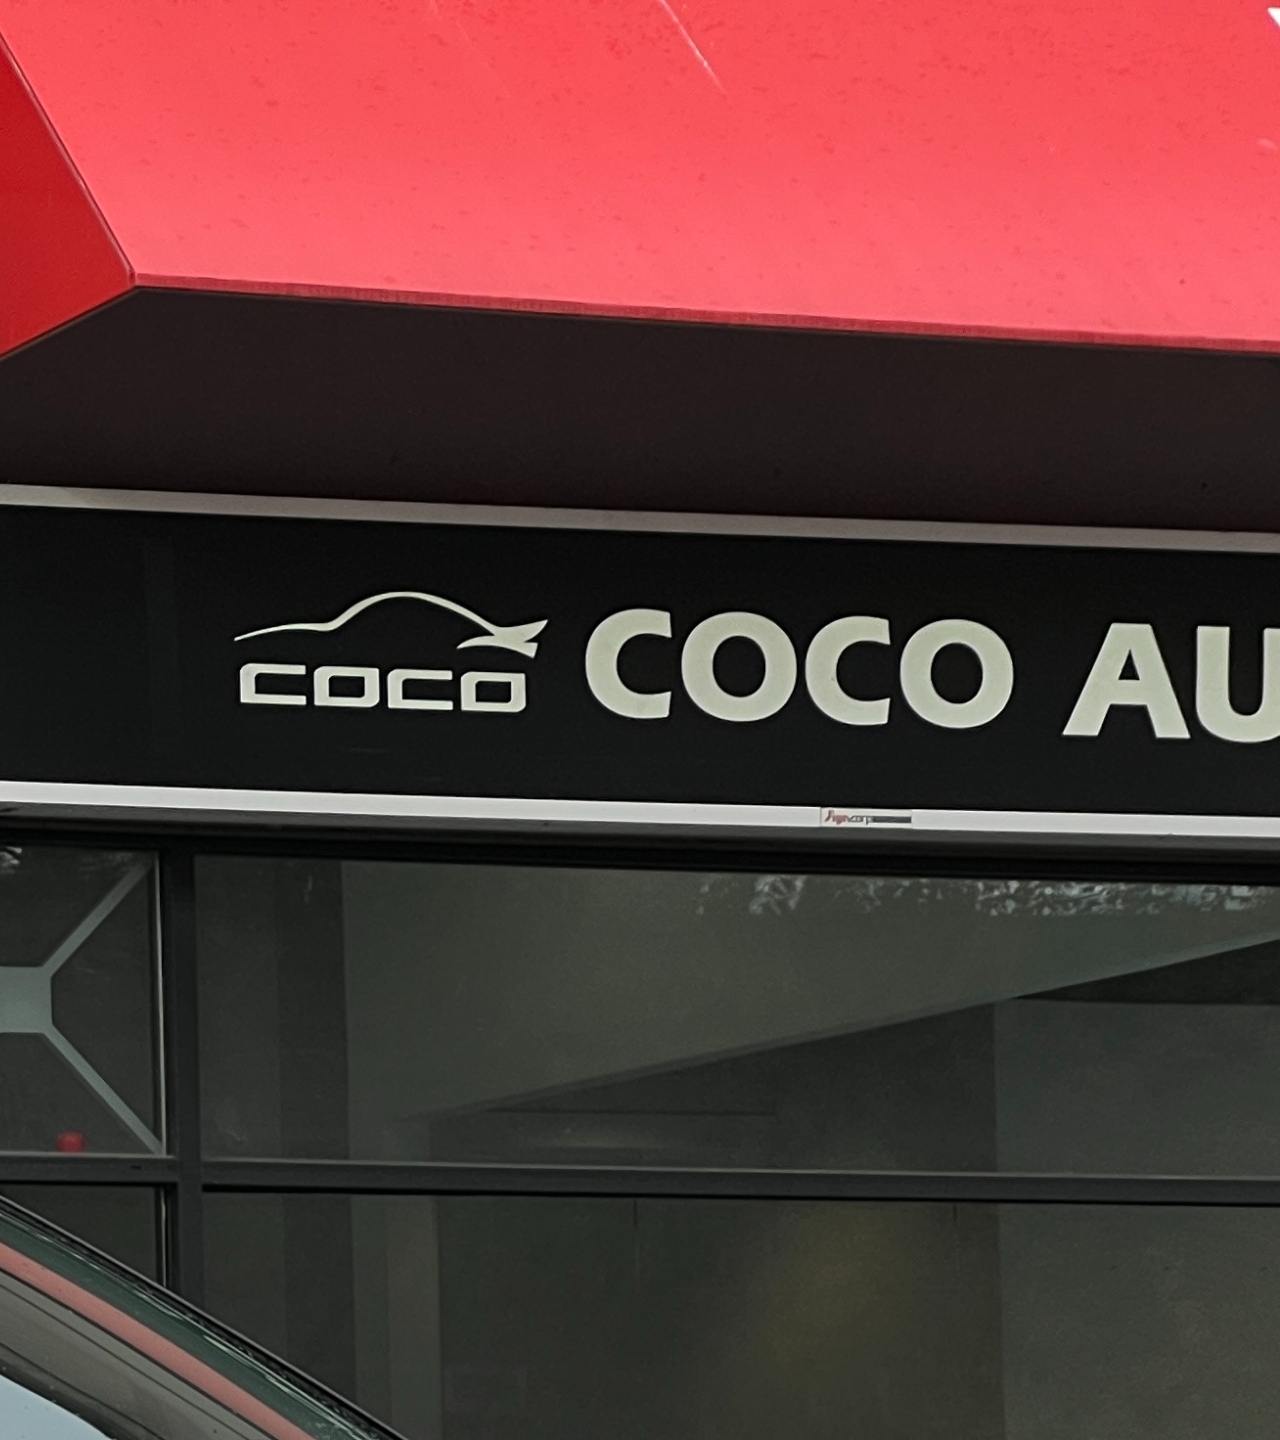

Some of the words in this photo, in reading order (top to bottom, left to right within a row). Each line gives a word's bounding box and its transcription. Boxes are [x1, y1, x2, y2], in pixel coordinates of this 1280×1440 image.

[239, 662, 528, 714] COCO
[585, 608, 1014, 729] COCO
[1061, 622, 1280, 743] AU
